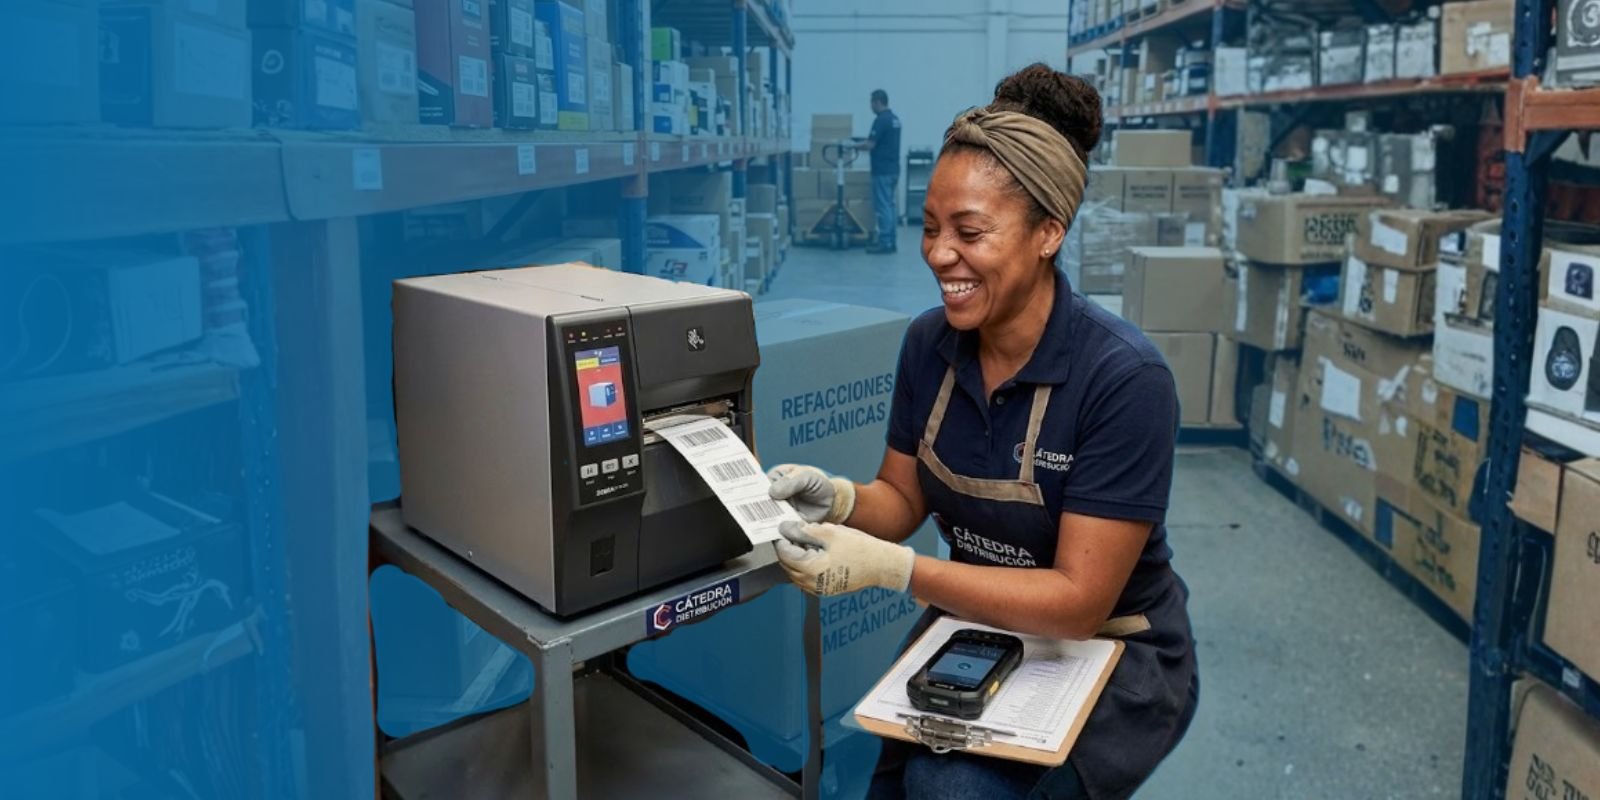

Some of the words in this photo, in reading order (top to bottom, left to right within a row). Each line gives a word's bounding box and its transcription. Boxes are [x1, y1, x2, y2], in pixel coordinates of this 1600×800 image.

[781, 373, 893, 420] REFACCIONES
[789, 402, 886, 447] MECÁNICAS
[1033, 448, 1074, 464] ÁTEDRA
[952, 526, 1033, 558] CÁTEDRA
[675, 584, 732, 613] CÁTEDRA
[823, 598, 917, 655] MECÁNICAS
